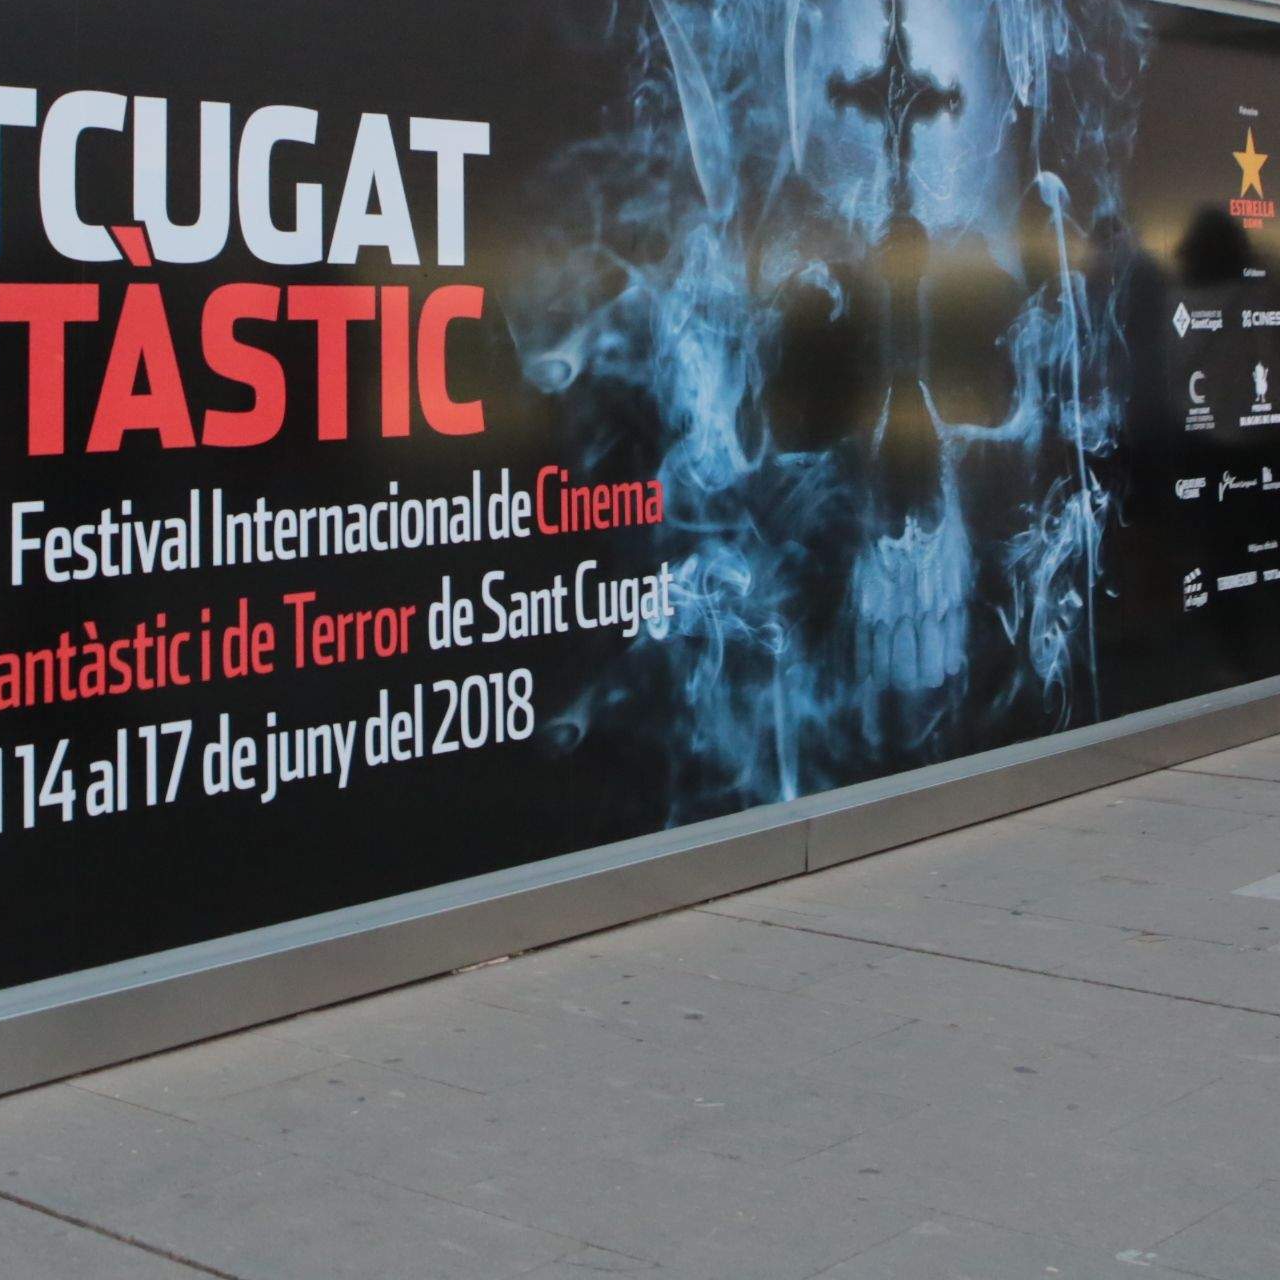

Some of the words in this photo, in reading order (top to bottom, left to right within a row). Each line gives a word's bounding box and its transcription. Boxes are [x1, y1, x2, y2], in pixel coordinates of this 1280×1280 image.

[11, 488, 200, 586] Festival
[212, 468, 483, 569] Internacional
[487, 467, 532, 542] de
[535, 464, 665, 536] Cinema
[201, 607, 212, 682] i
[222, 597, 275, 680] de
[282, 591, 417, 669] Terror
[428, 575, 474, 650] de
[481, 570, 569, 643] Sant
[574, 559, 675, 641] Cugat
[14, 738, 78, 829] 14
[85, 728, 128, 817] al
[138, 719, 194, 806] 17
[202, 712, 257, 796] de
[260, 711, 358, 804] juny
[364, 683, 424, 767] del
[431, 667, 536, 756] 2018
